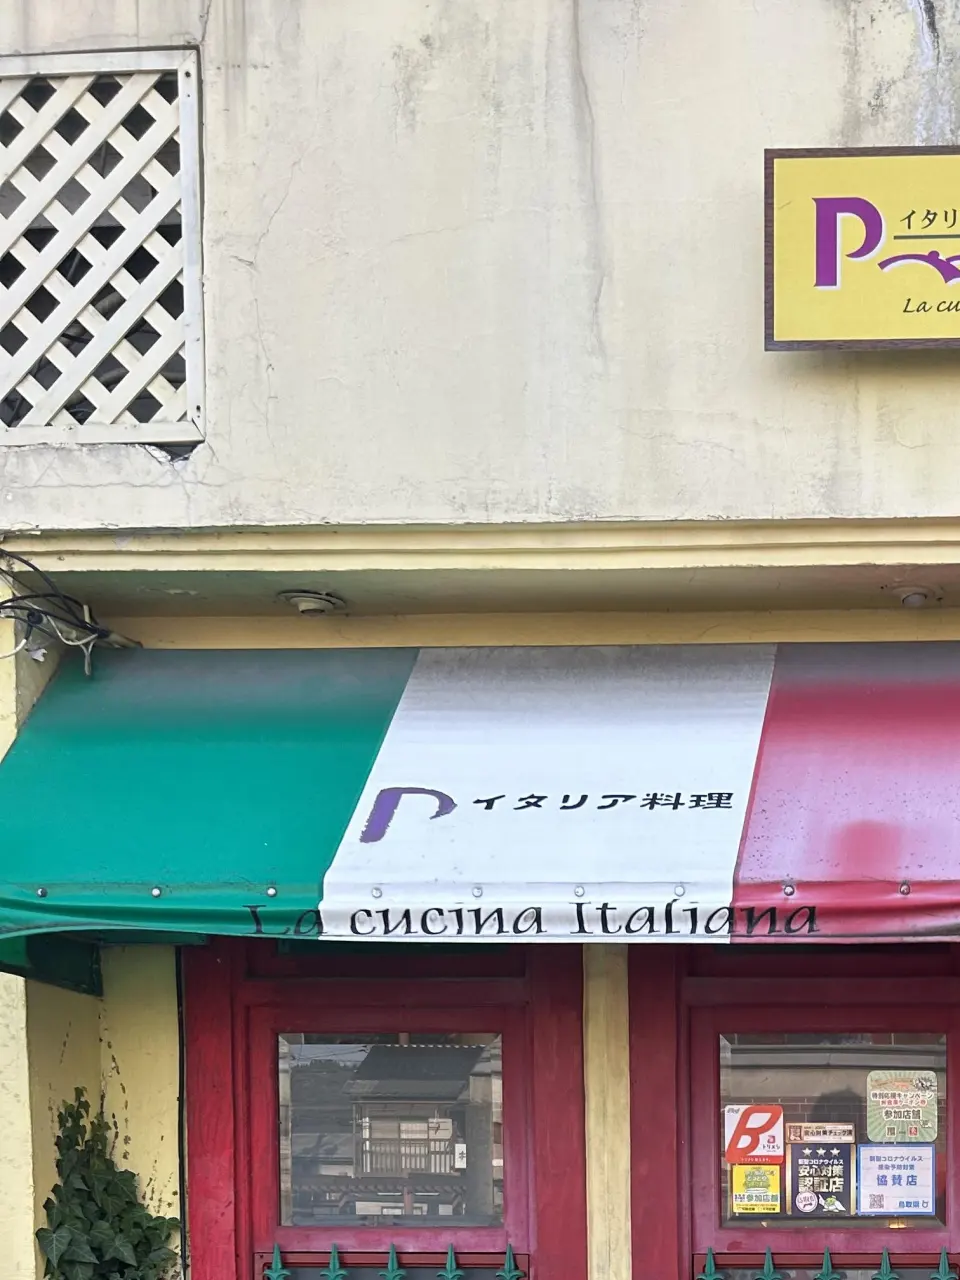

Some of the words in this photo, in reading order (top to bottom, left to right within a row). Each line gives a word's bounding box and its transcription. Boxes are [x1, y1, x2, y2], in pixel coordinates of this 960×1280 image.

[812, 197, 883, 287] P
[903, 298, 932, 313] La
[473, 791, 733, 811] イタリア料理
[243, 904, 328, 935] La
[350, 902, 547, 935] cucina
[568, 899, 820, 935] Italiana
[884, 1109, 921, 1120] 参加店舗
[799, 1165, 844, 1177] 安心対策
[799, 1177, 844, 1193] 認証店
